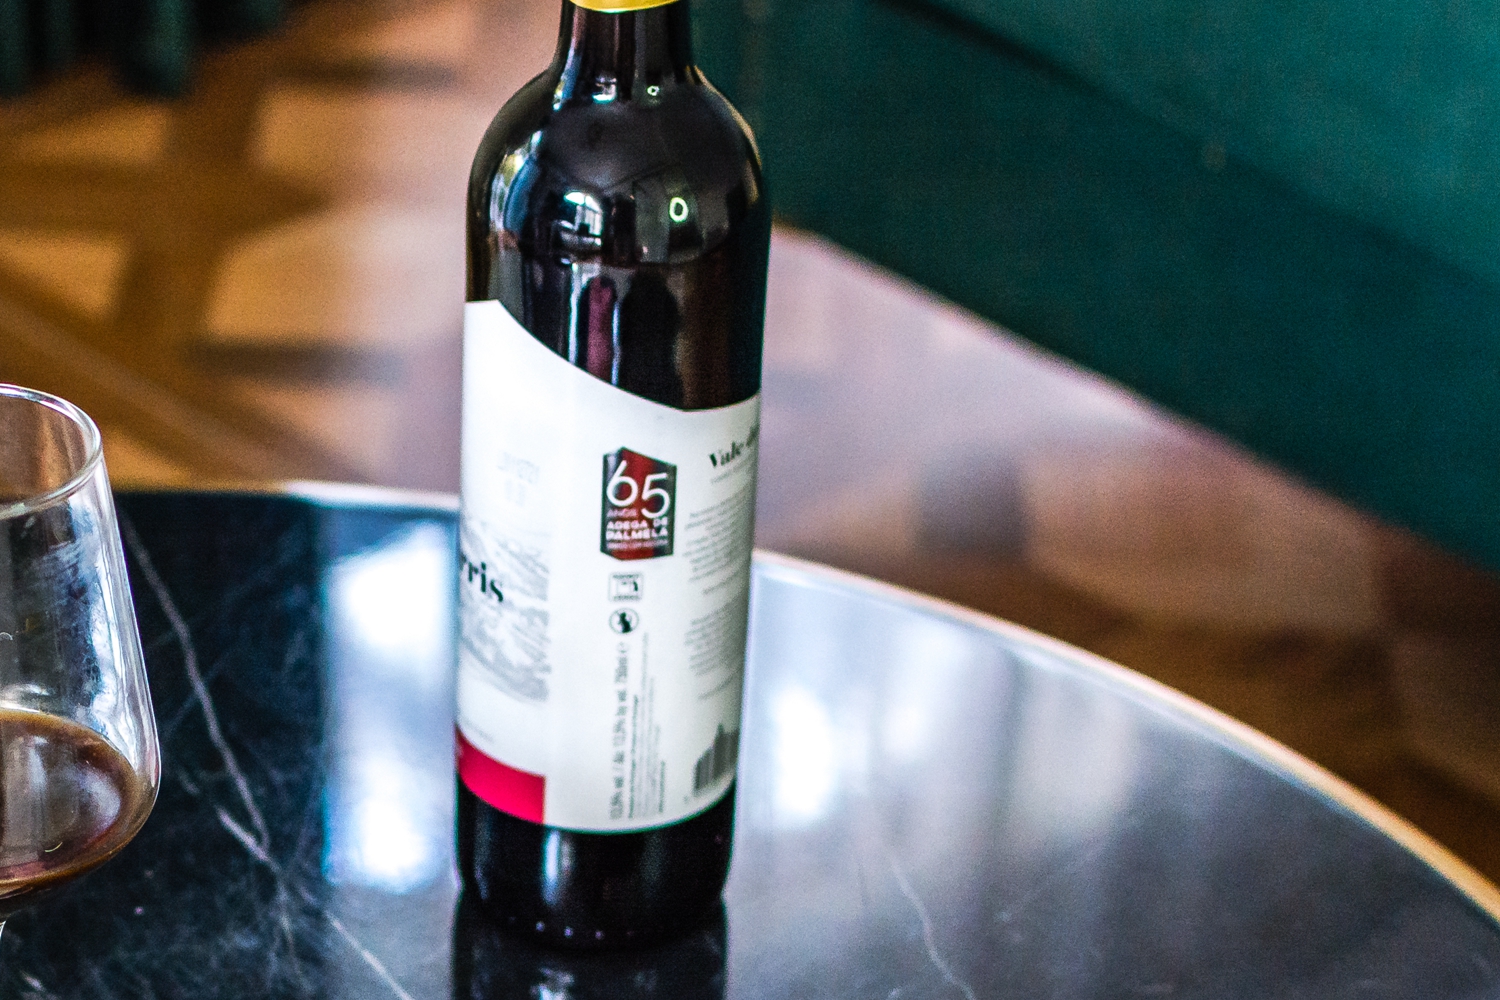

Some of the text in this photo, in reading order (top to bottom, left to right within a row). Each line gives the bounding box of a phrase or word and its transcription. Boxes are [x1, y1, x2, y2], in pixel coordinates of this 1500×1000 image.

[606, 459, 670, 519] 65
[606, 516, 668, 530] ADEGA DE
[606, 527, 668, 540] PALMELA
